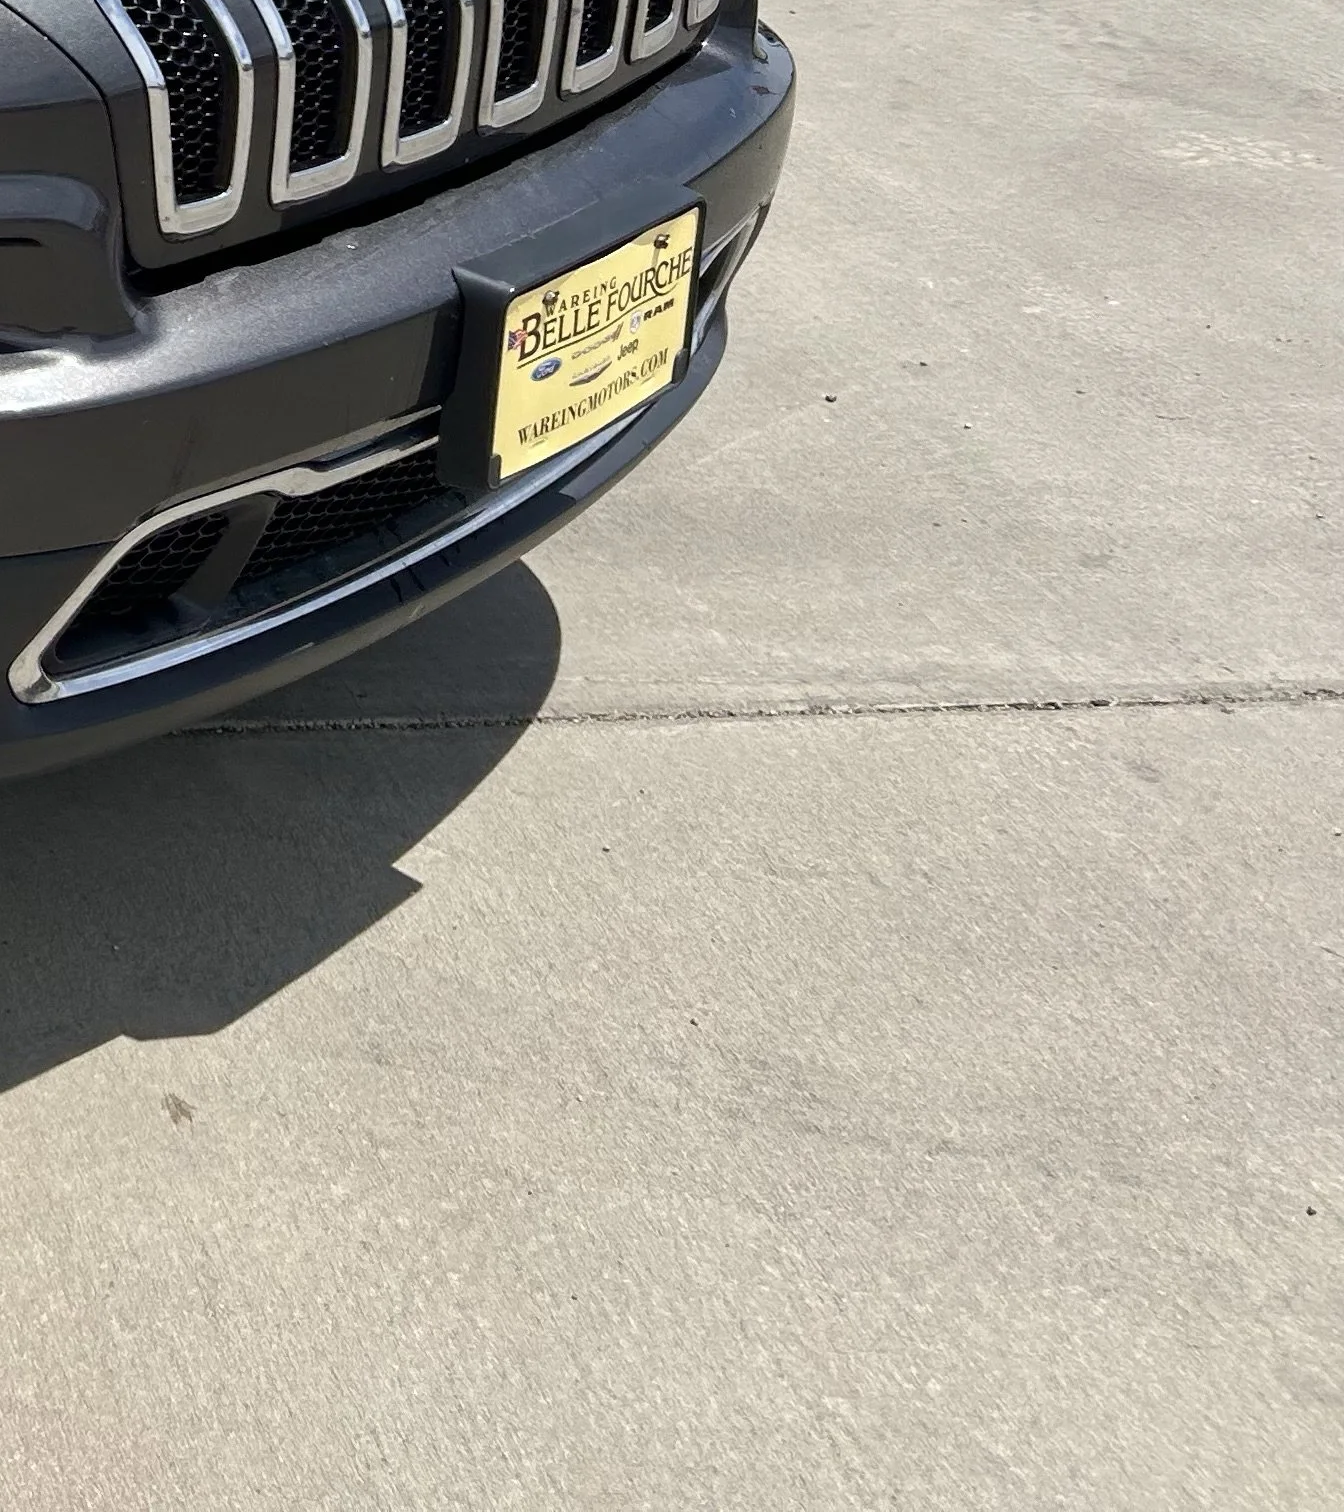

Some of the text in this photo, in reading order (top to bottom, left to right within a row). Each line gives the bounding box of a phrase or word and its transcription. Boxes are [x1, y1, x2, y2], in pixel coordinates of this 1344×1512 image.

[518, 247, 693, 362] BELLE FOURCHE
[544, 276, 617, 318] WAREING
[643, 298, 675, 321] RAM
[617, 338, 640, 361] Jeep
[517, 347, 669, 446] WAREINGMOTORS.COM
